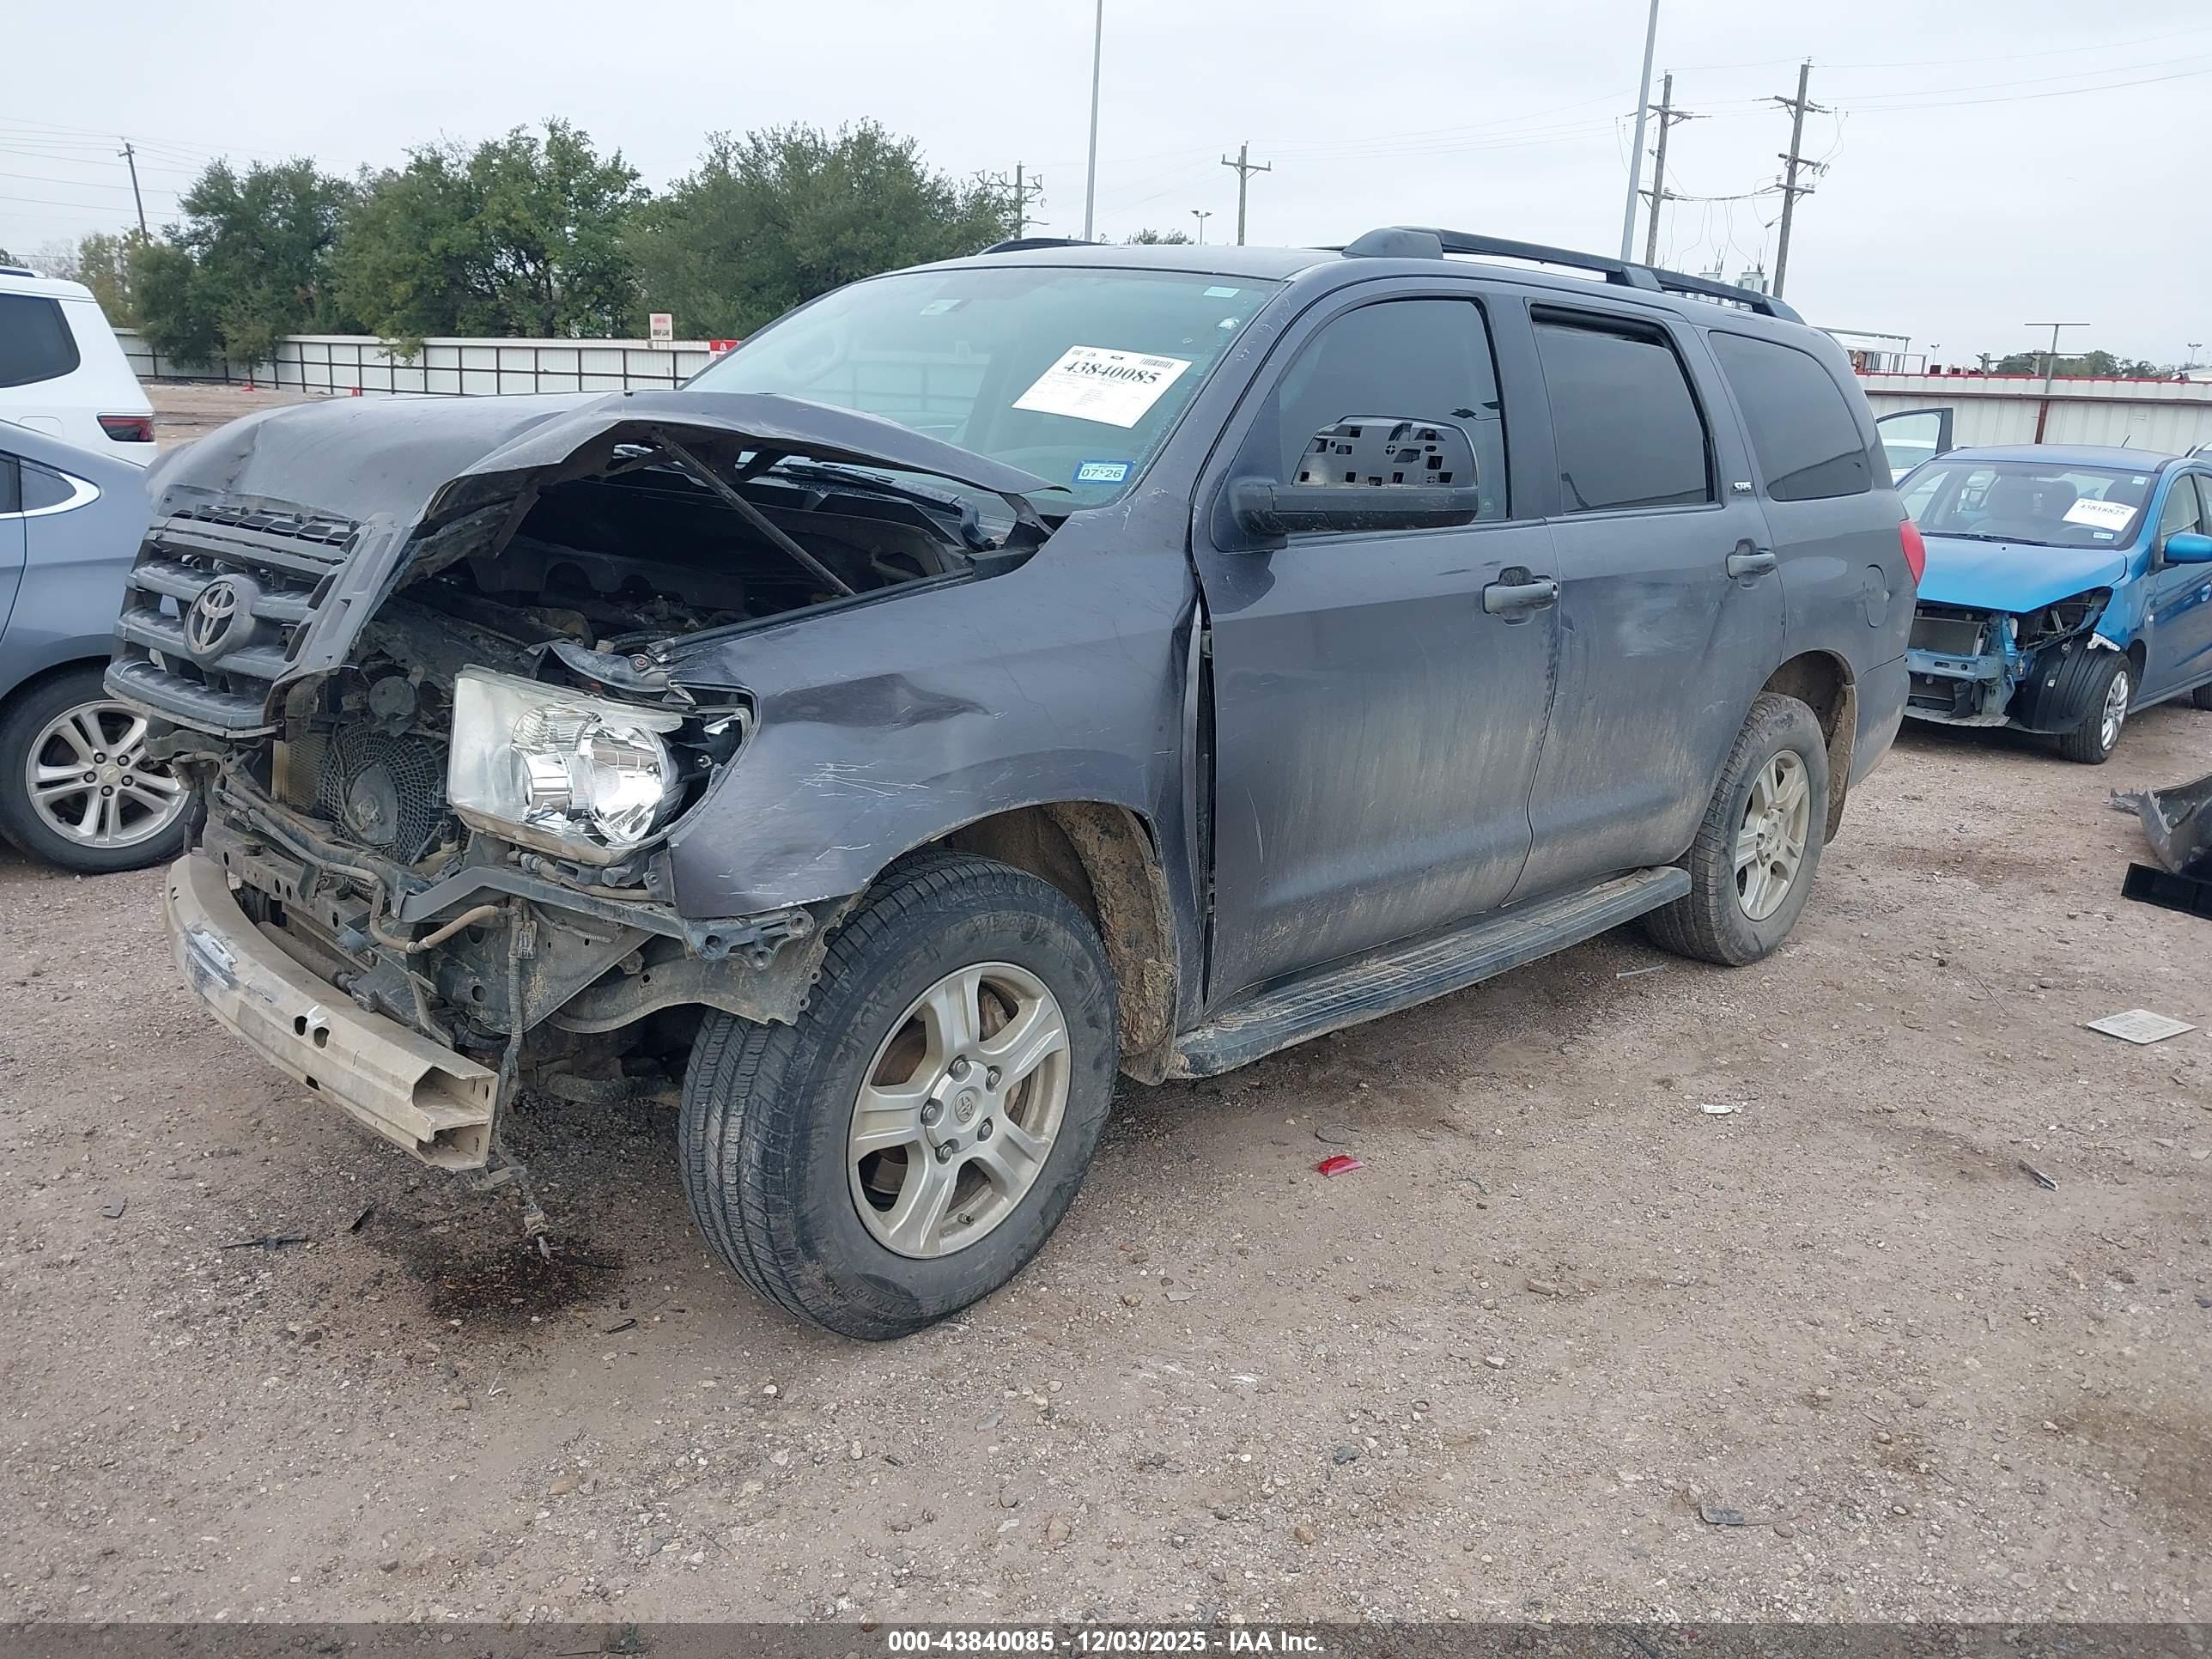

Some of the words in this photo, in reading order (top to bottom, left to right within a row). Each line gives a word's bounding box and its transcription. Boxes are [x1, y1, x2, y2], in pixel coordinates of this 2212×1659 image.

[1064, 360, 1162, 385] 43840085
[1081, 468, 1099, 477] 07
[1104, 469, 1122, 478] 26
